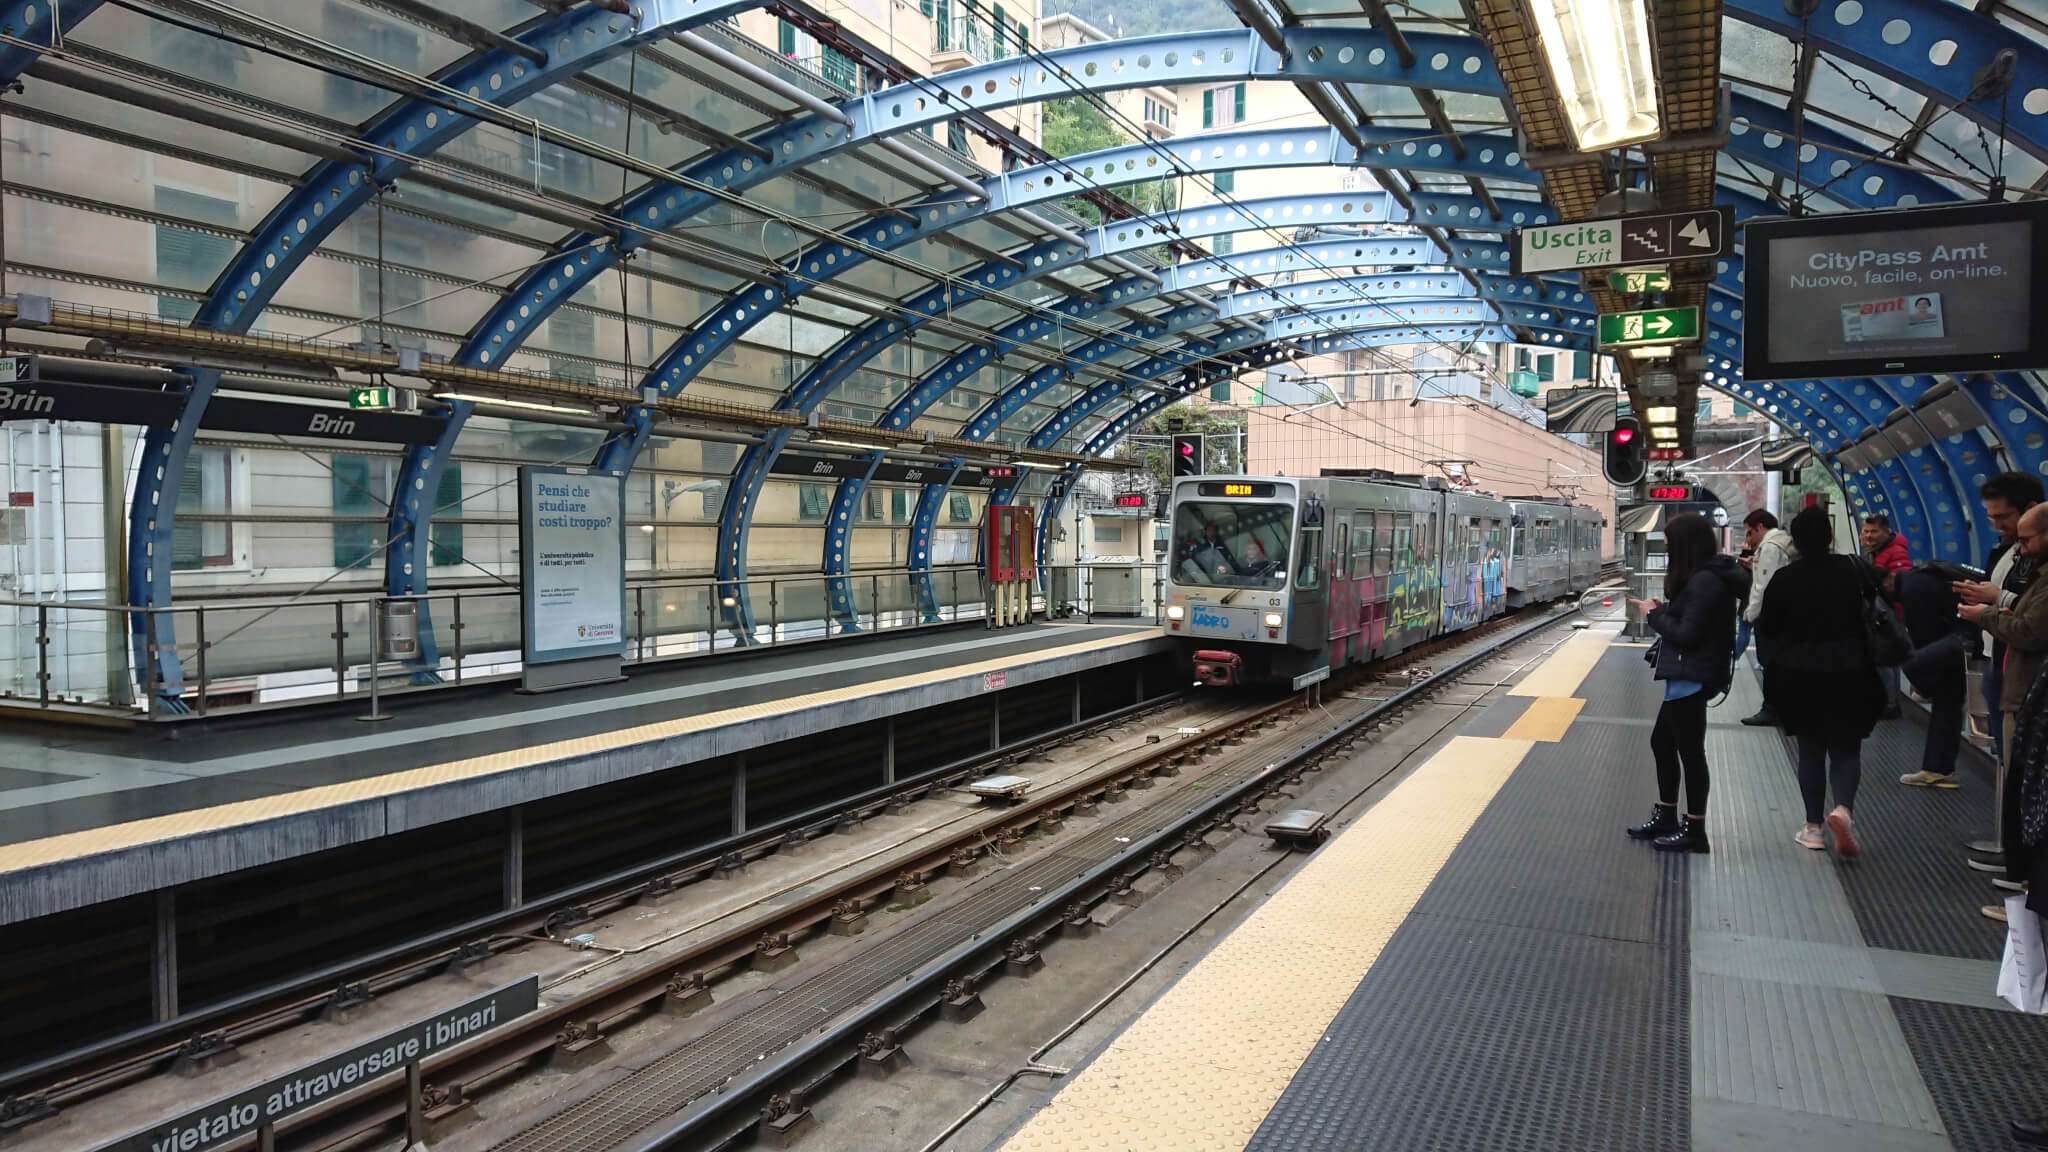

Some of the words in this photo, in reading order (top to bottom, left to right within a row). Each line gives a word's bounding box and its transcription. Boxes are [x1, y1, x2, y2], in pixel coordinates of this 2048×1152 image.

[1531, 226, 1612, 249] Uscita
[1576, 248, 1612, 265] Exit
[1808, 249, 1922, 271] CityPass
[1931, 242, 1988, 262] Amt
[1790, 273, 1857, 289] Nuovo,
[1865, 268, 1922, 285] facile,
[1930, 264, 2008, 280] on-line.
[1861, 295, 1905, 315] amt
[308, 413, 355, 434] Brin
[813, 461, 833, 474] Brin
[905, 469, 922, 480] Brin
[537, 483, 569, 497] Pensi
[571, 485, 591, 497] che
[1225, 484, 1252, 495] BRIN
[538, 500, 586, 512] studiare
[539, 515, 567, 527] costi
[570, 516, 612, 530] troppo?
[1269, 598, 1280, 606] 03
[152, 1103, 259, 1152] vietato
[266, 1038, 419, 1116] attraversare
[426, 1025, 431, 1050] i
[436, 1000, 496, 1046] binari
